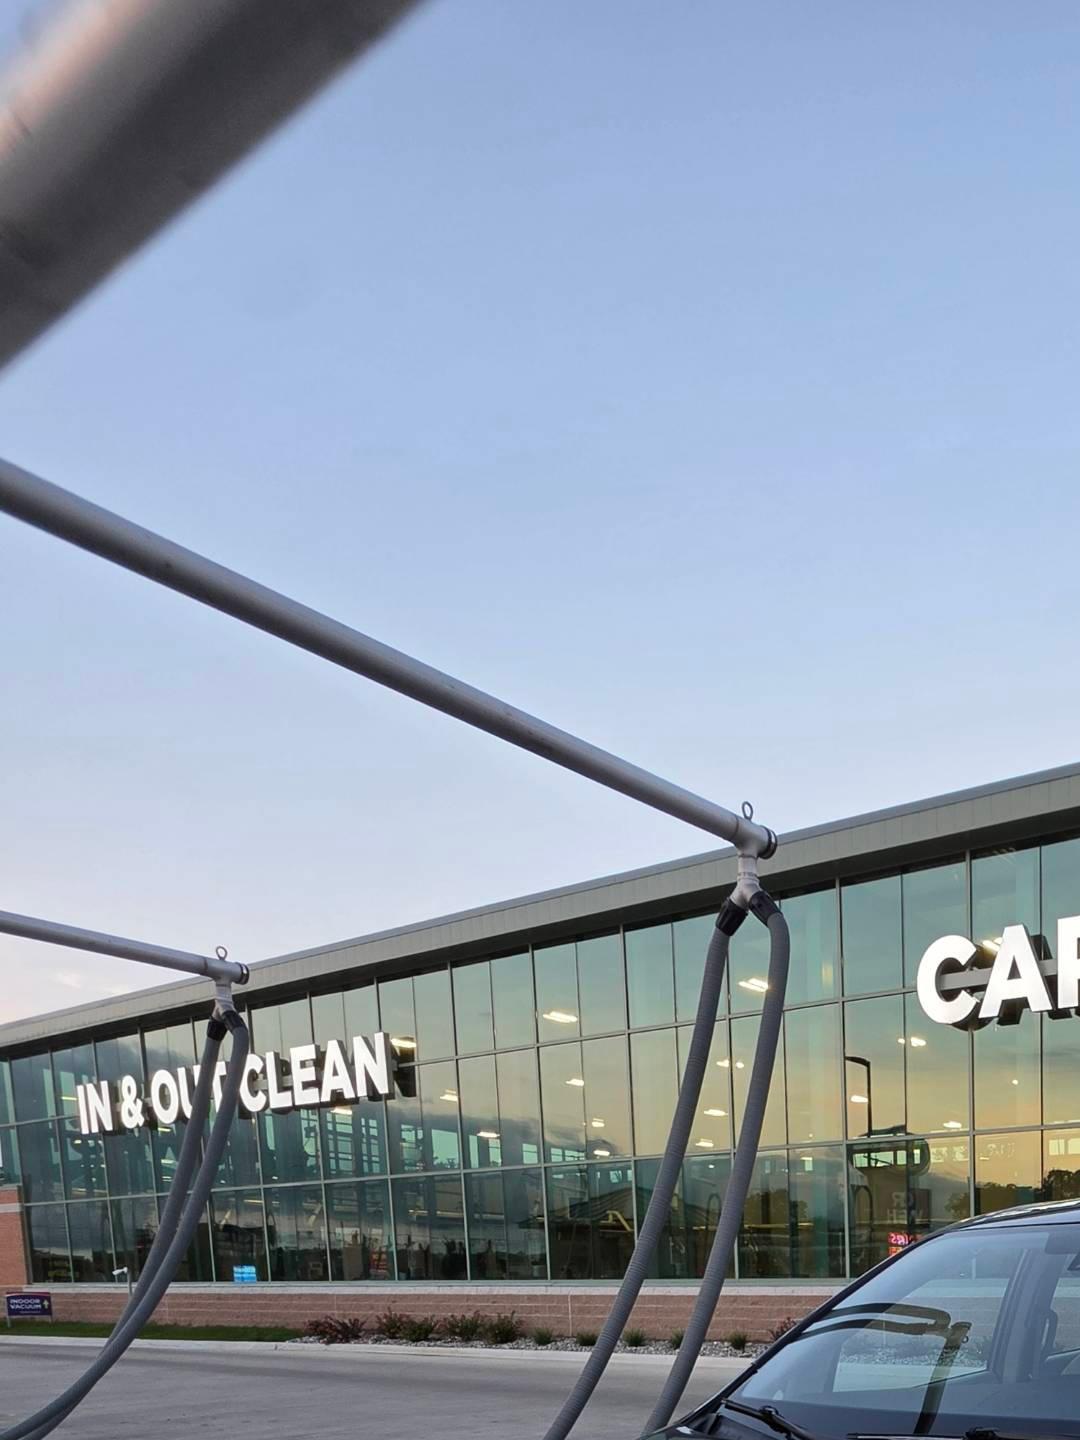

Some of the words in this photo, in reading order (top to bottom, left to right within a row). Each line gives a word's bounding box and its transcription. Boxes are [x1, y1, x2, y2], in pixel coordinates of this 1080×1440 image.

[76, 1080, 113, 1135] IN
[120, 1075, 145, 1129] &
[239, 1031, 390, 1112] CLEAN
